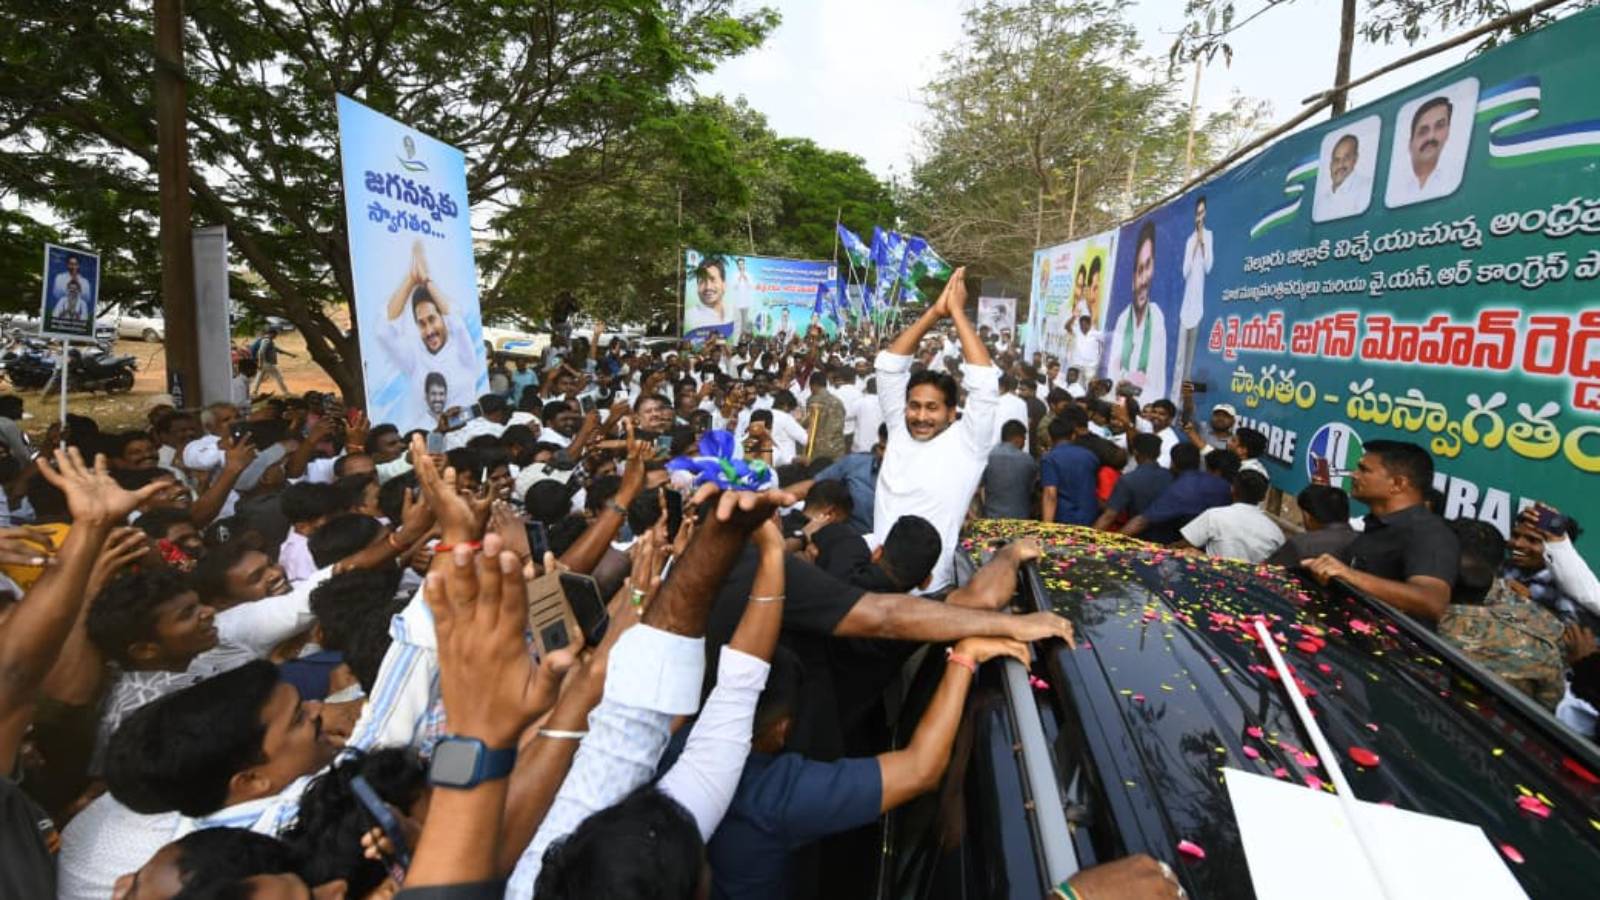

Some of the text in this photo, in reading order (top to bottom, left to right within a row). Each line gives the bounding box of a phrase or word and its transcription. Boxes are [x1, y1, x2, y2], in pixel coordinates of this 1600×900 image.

[365, 170, 458, 222] జగనన్నకు
[367, 201, 445, 238] స్వాగతం...
[1244, 249, 1284, 273] నెల్లూరు
[1335, 215, 1482, 263] విచ్చేయుచున్న
[1322, 276, 1367, 294] మరియు
[1476, 251, 1570, 289] కాంగ్రెస్
[1291, 310, 1360, 358] జగన్
[1361, 308, 1520, 371] మోహన్
[1231, 364, 1316, 408] స్వాగతం
[1347, 378, 1600, 473] సుస్వాగతం
